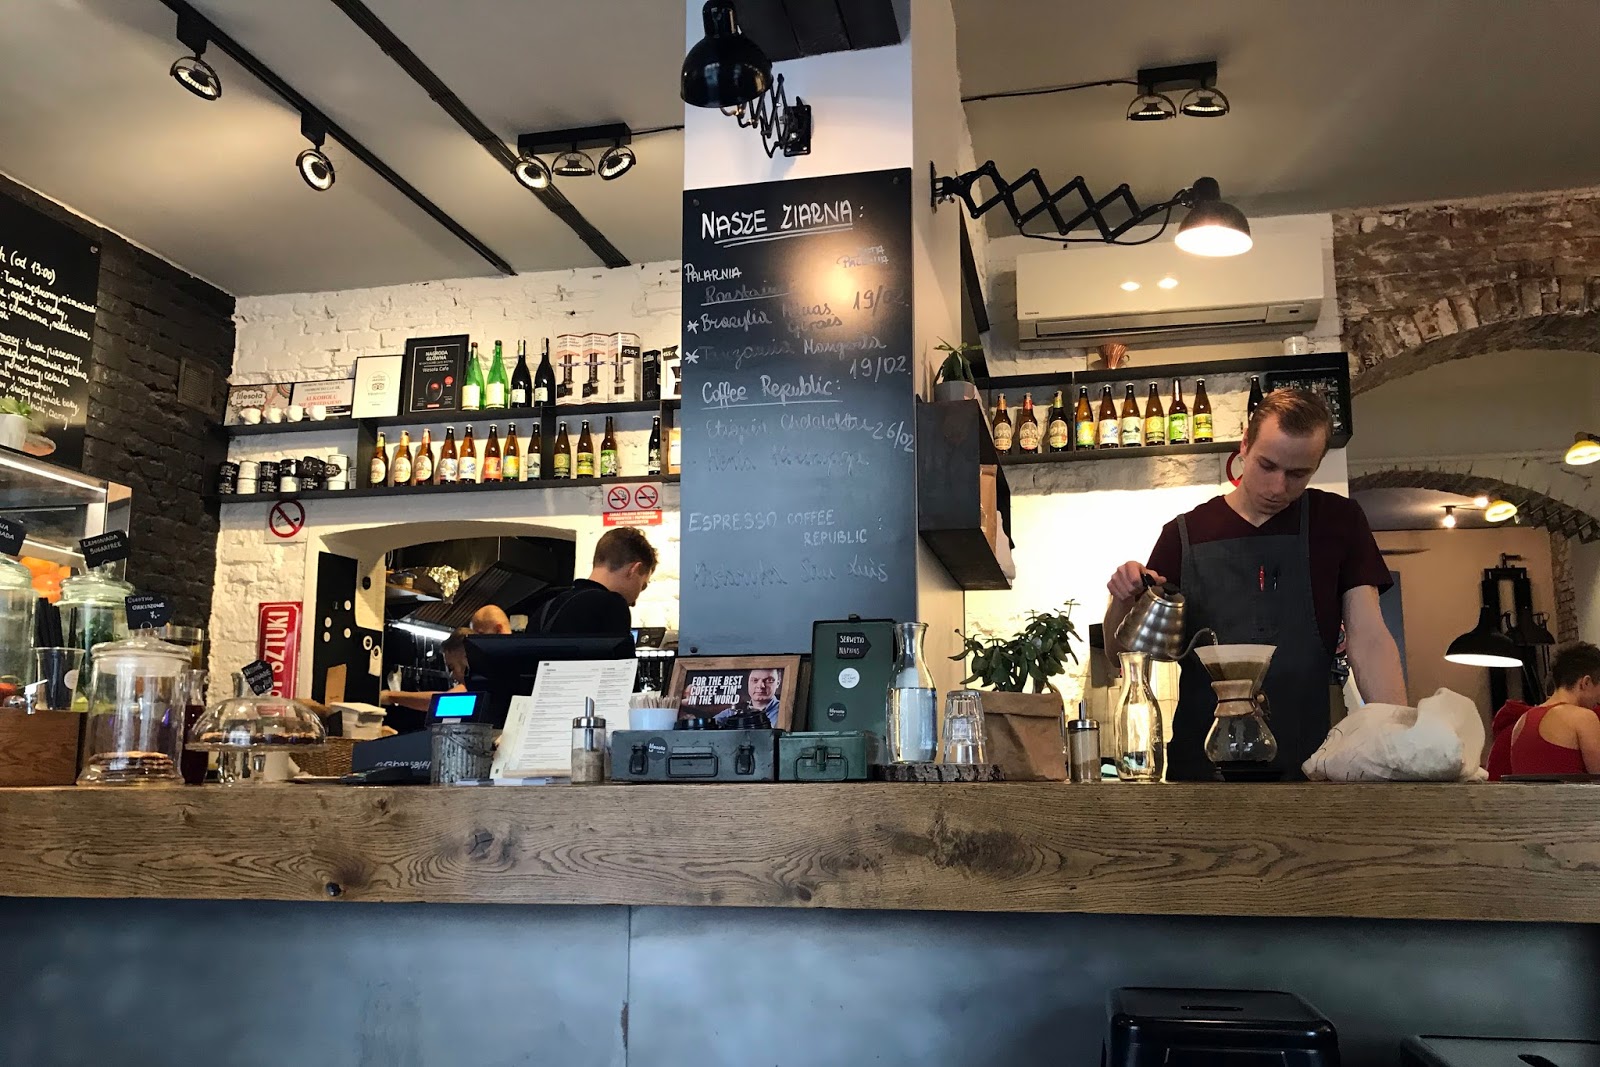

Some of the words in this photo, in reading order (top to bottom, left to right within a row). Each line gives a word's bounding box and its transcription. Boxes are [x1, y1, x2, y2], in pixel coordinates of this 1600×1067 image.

[701, 209, 768, 240] NASZE
[31, 261, 56, 286] 13:00)
[684, 262, 743, 284] PALARNIA
[702, 381, 748, 409] Coffee
[872, 421, 914, 453] 26/02
[688, 512, 777, 532] ESPRESSO
[786, 509, 835, 526] COFFEE
[264, 611, 290, 673] SZTUKI
[690, 685, 719, 696] COFFEE
[720, 685, 742, 695] "TIM"
[692, 676, 707, 686] FOR
[708, 676, 722, 686] THE
[723, 675, 743, 686] BEST
[688, 696, 697, 705] IN
[697, 695, 713, 705] THE
[714, 695, 740, 705] WORLD
